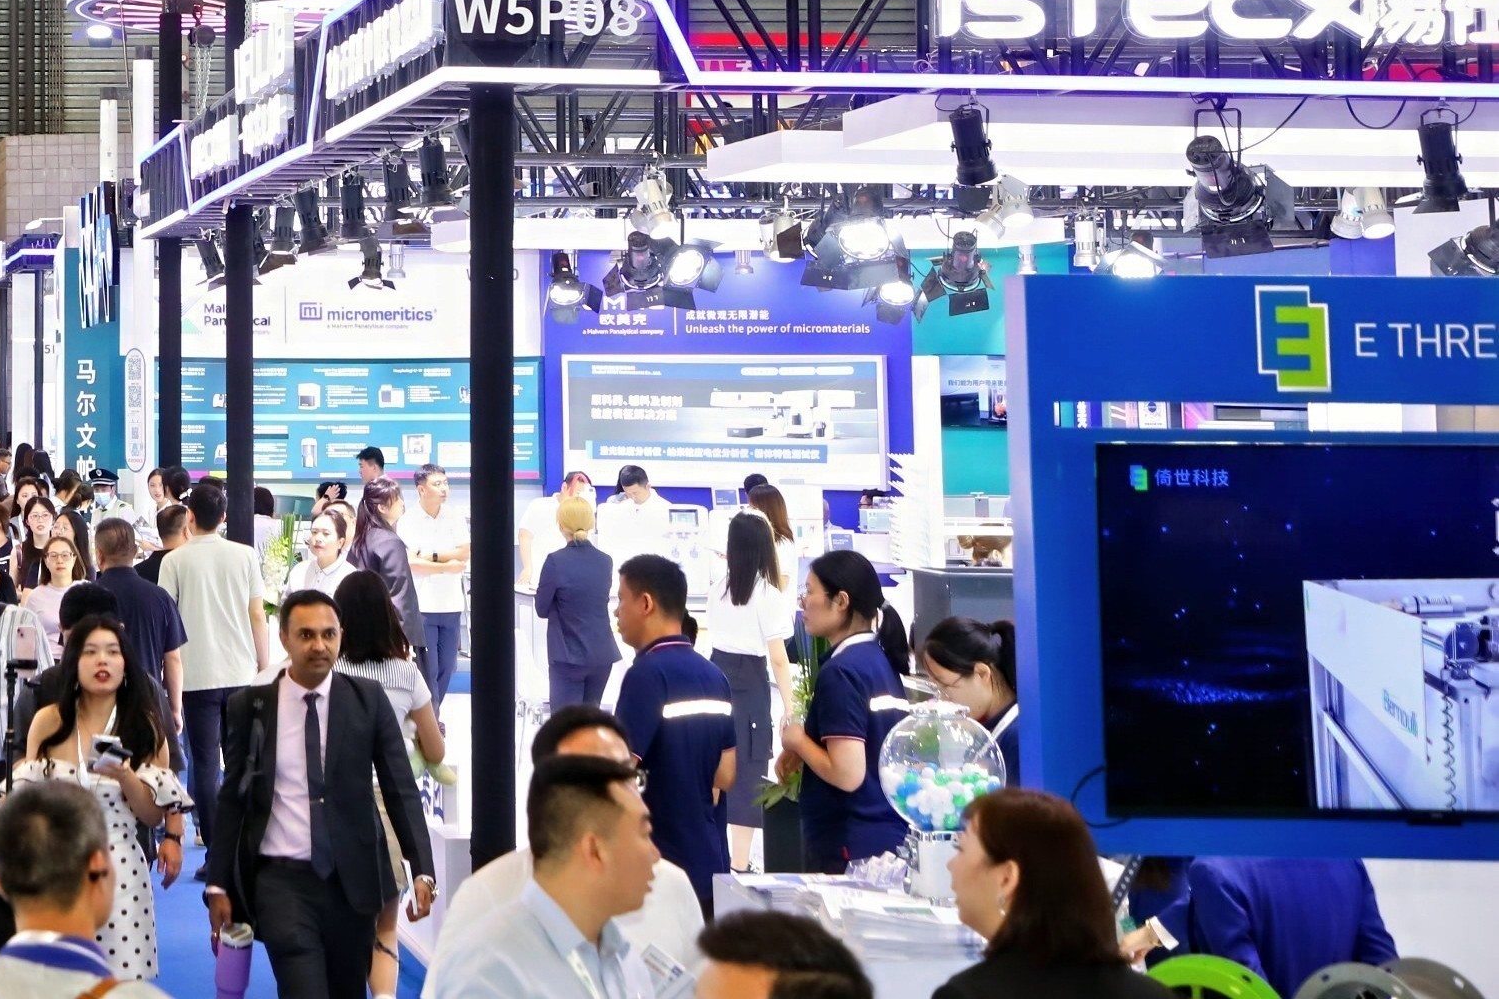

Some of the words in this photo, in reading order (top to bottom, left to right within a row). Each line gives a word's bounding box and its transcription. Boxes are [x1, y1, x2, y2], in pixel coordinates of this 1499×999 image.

[204, 315, 270, 326] Pancal
[327, 307, 433, 321] micromeritics
[599, 313, 647, 326] 欧美克
[685, 309, 770, 321] 成就微观无限潜能
[685, 324, 725, 335] Unleash
[728, 324, 744, 335] the
[747, 326, 777, 337] power
[780, 323, 791, 334] of
[793, 323, 871, 335] micromaterials
[1355, 323, 1378, 357] E
[1388, 323, 1498, 358] THRE
[1154, 468, 1230, 487] 倚世科技
